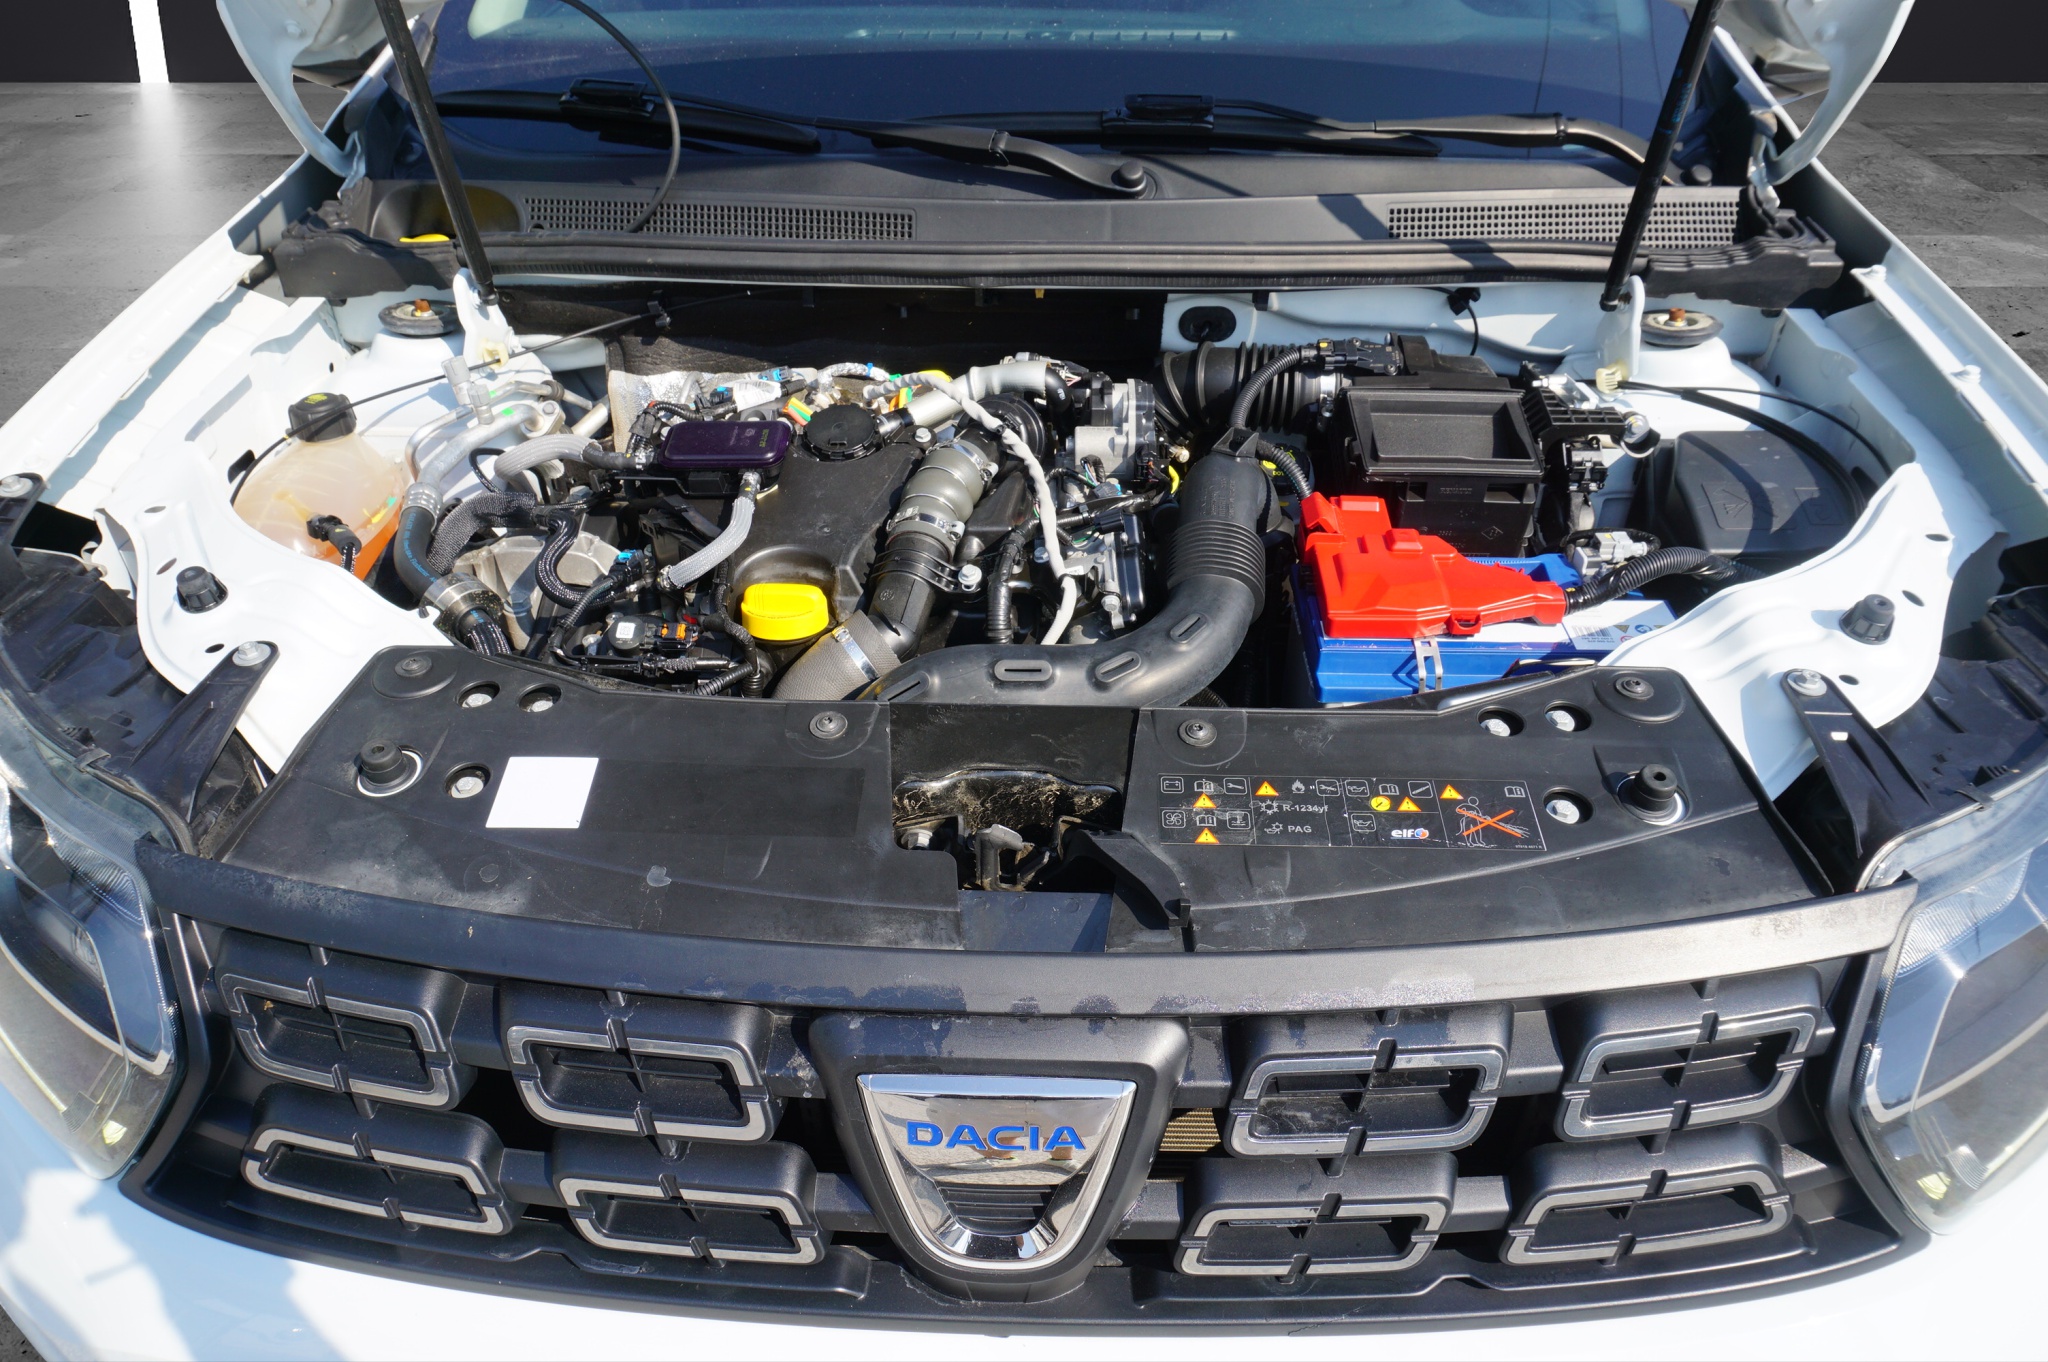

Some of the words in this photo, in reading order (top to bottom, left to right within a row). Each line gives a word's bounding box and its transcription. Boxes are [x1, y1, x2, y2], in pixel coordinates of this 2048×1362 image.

[1283, 804, 1329, 814] R-1234yf
[1288, 825, 1312, 833] PAG
[1391, 828, 1415, 837] elf
[906, 1121, 1085, 1151] DACIA
